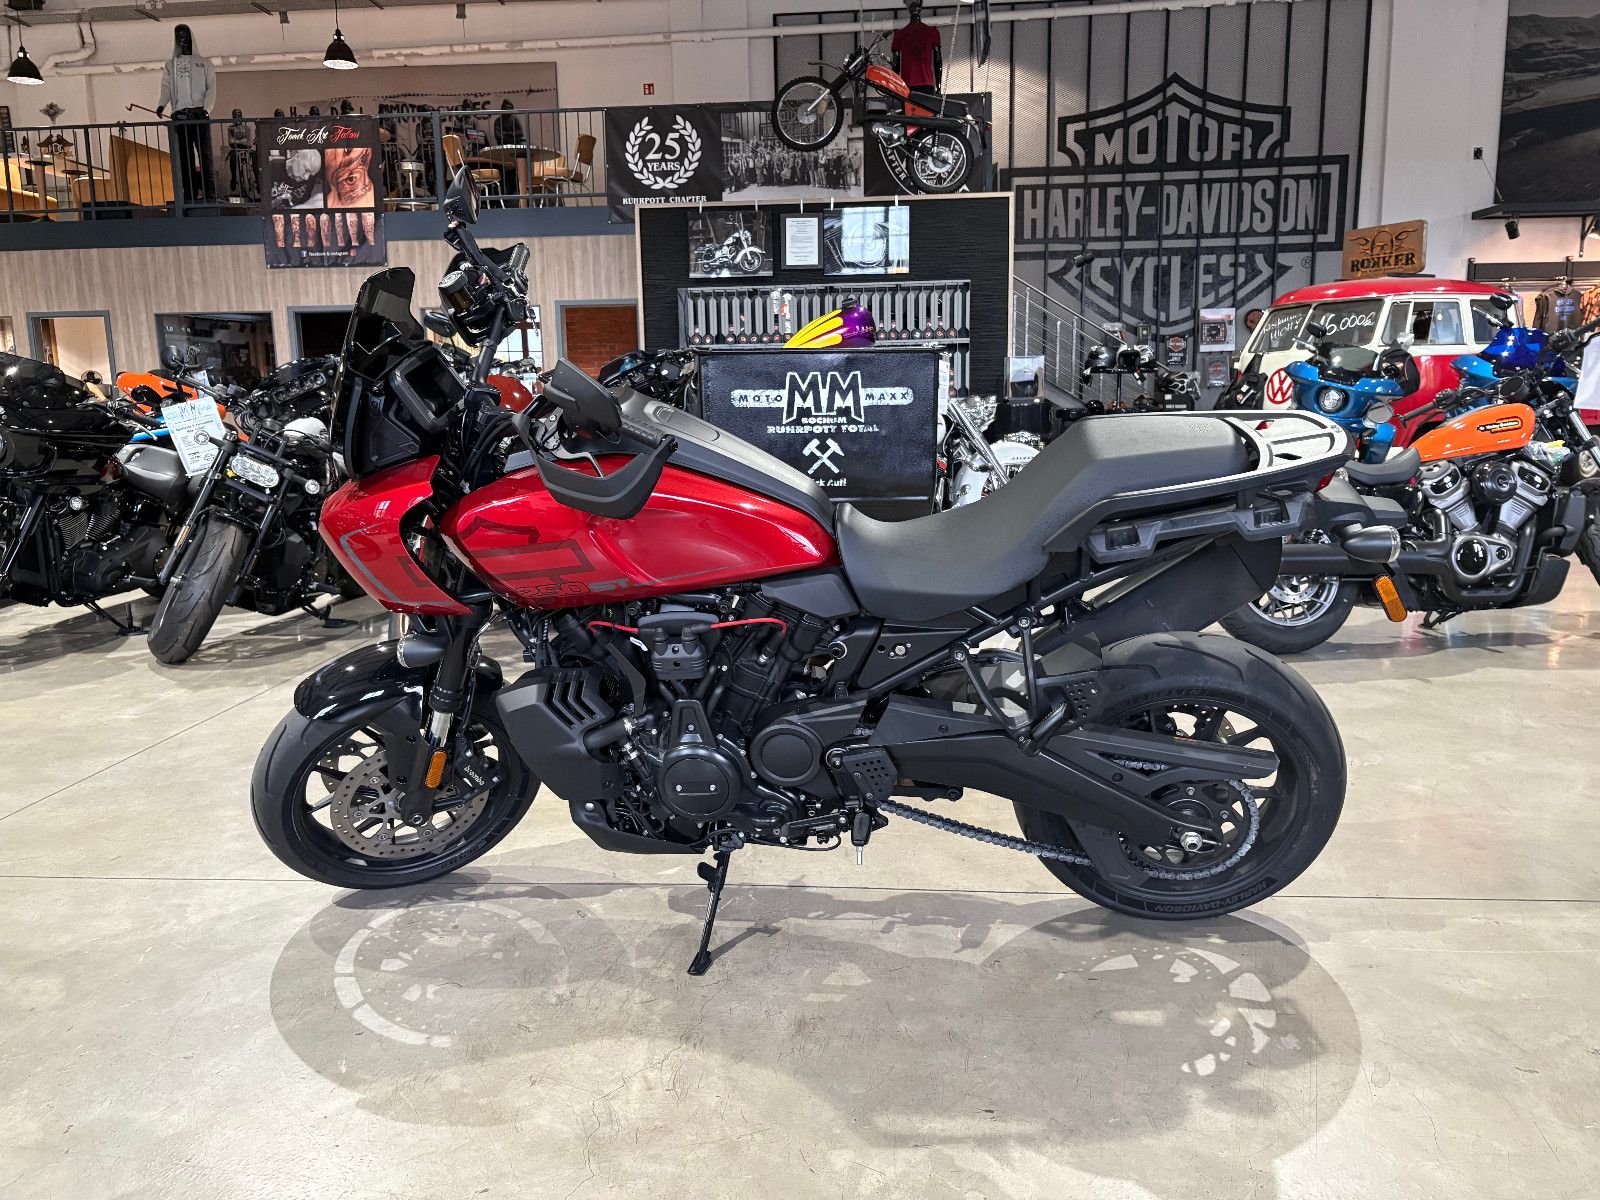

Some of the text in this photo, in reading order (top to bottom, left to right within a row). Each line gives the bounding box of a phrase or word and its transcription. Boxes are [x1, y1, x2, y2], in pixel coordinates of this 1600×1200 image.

[1092, 100, 1254, 166] MOTOR
[644, 132, 681, 160] 25
[646, 161, 681, 172] YEARS
[622, 195, 708, 205] RUHRPOTT CHAPTER
[1022, 176, 1323, 240] HARLEY-DAVIDSON
[1350, 252, 1416, 272] ROKKER
[738, 370, 908, 425] MOTO MM MAXX
[766, 423, 880, 435] RUHRPOTT TOTAL
[801, 416, 848, 425] BOCHUM
[463, 764, 486, 786] brembo
